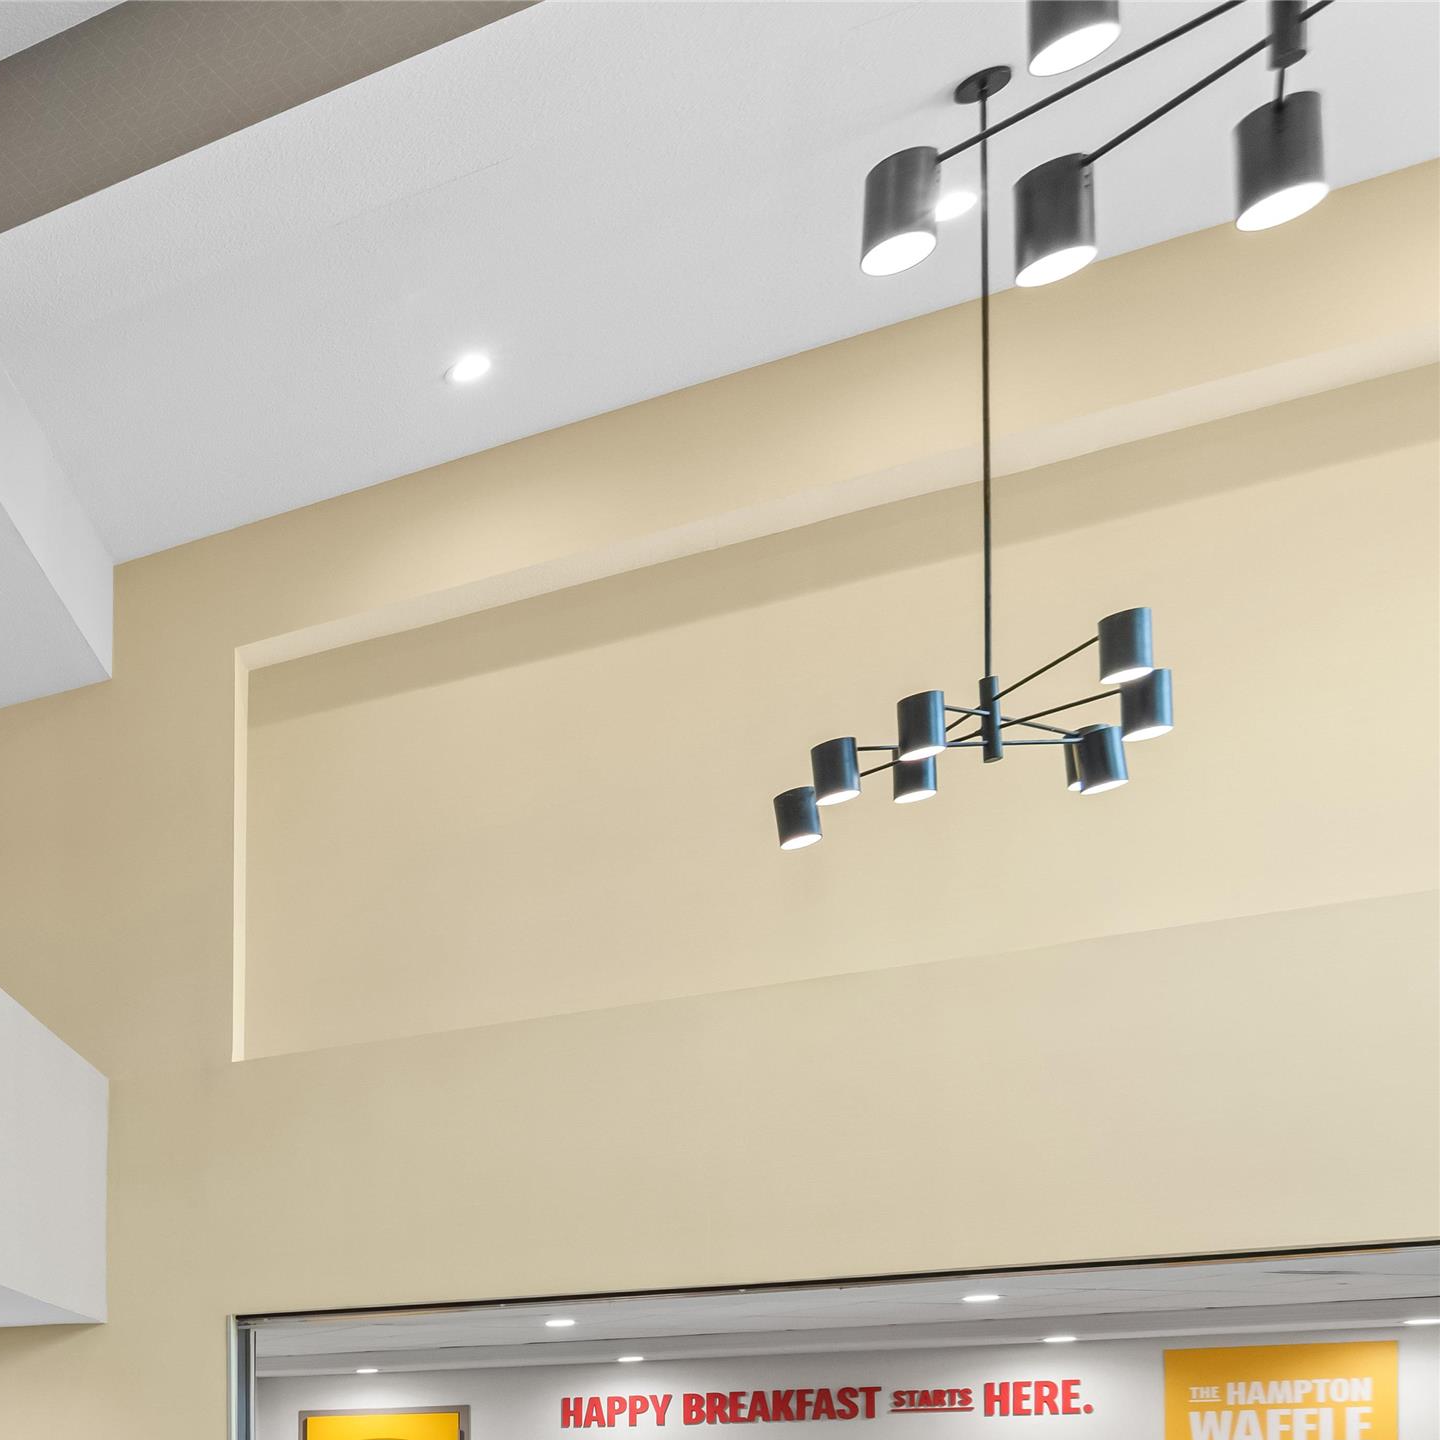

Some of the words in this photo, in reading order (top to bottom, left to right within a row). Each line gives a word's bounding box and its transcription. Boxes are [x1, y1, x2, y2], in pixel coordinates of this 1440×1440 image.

[561, 1394, 672, 1428] HAPPY
[683, 1386, 882, 1425] BREAKFAST
[892, 1388, 973, 1408] STARTS
[984, 1379, 1094, 1417] HERE.
[1189, 1386, 1220, 1399] THE
[1226, 1377, 1373, 1405] HAMPTON
